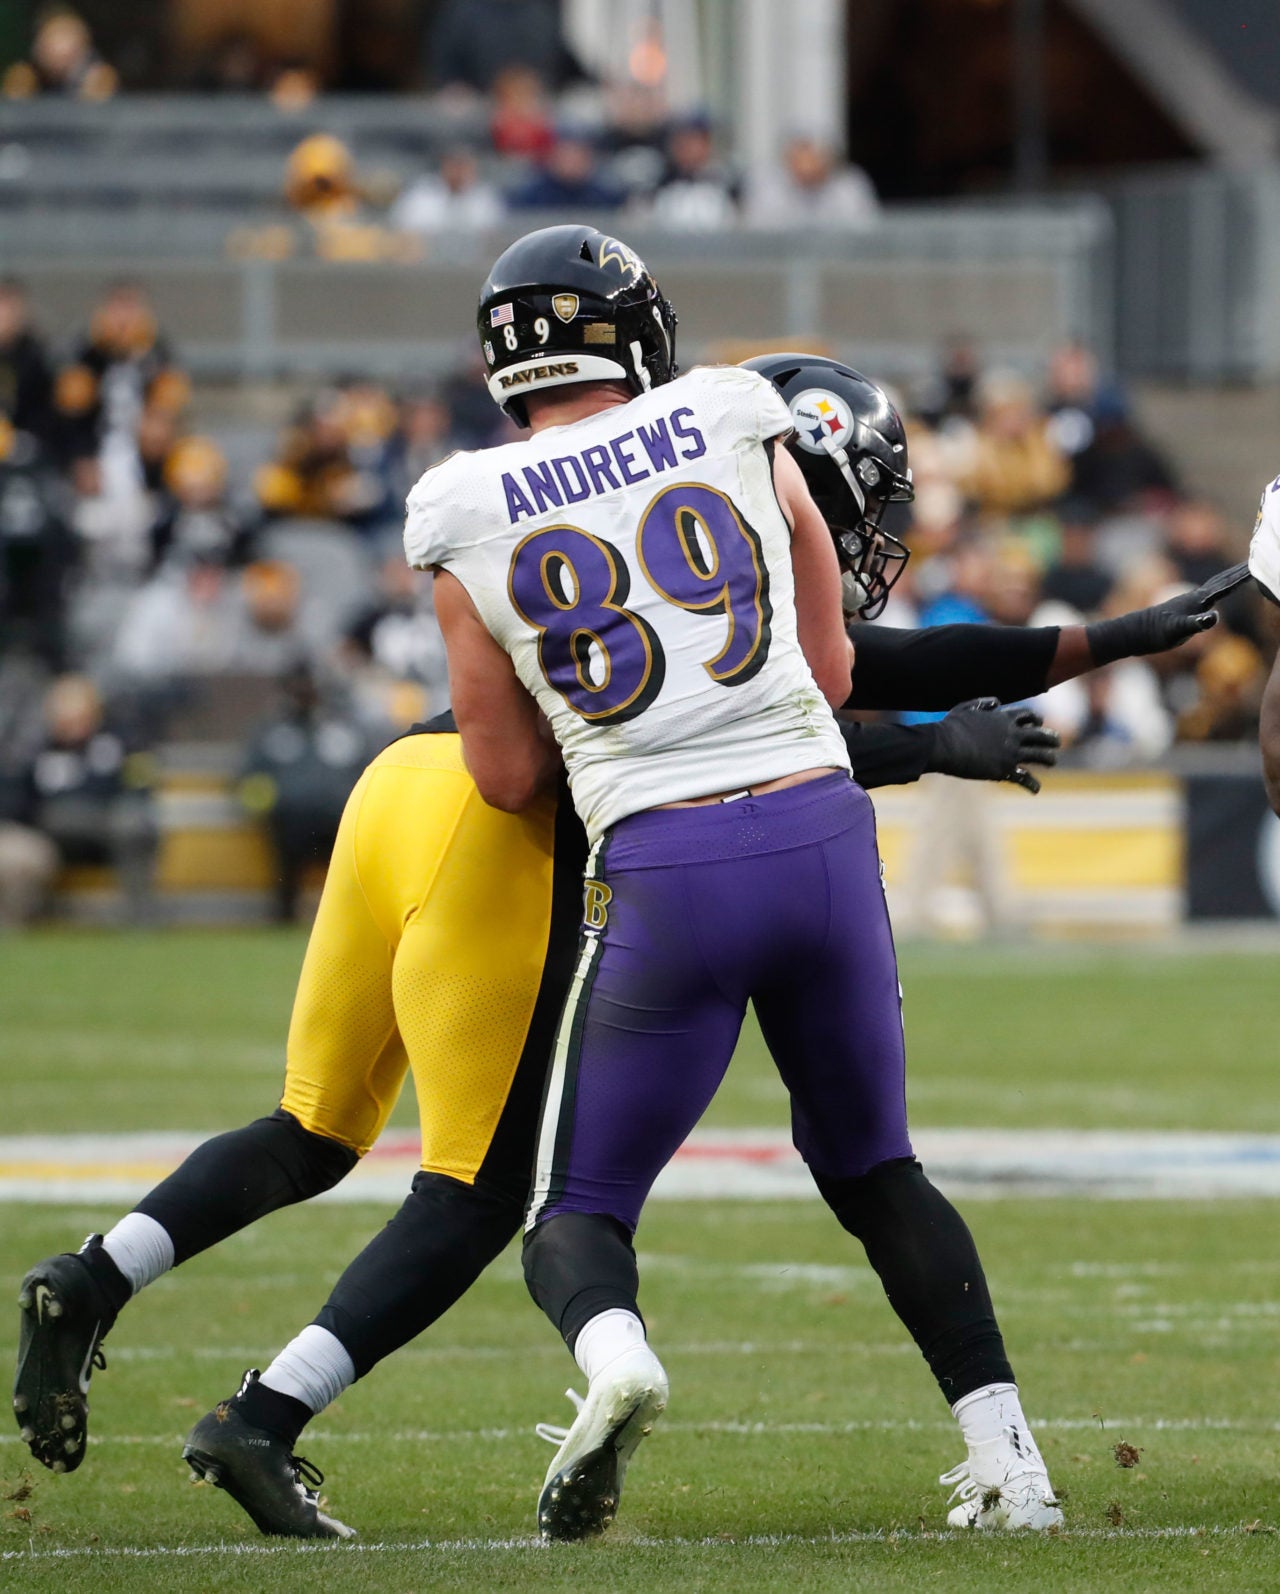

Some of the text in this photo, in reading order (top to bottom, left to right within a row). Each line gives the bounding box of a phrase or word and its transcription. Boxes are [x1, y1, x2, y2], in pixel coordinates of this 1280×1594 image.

[498, 361, 579, 389] RAVENS
[796, 408, 820, 421] Steelers
[500, 406, 707, 524] ANDREWS
[507, 481, 774, 727] 89
